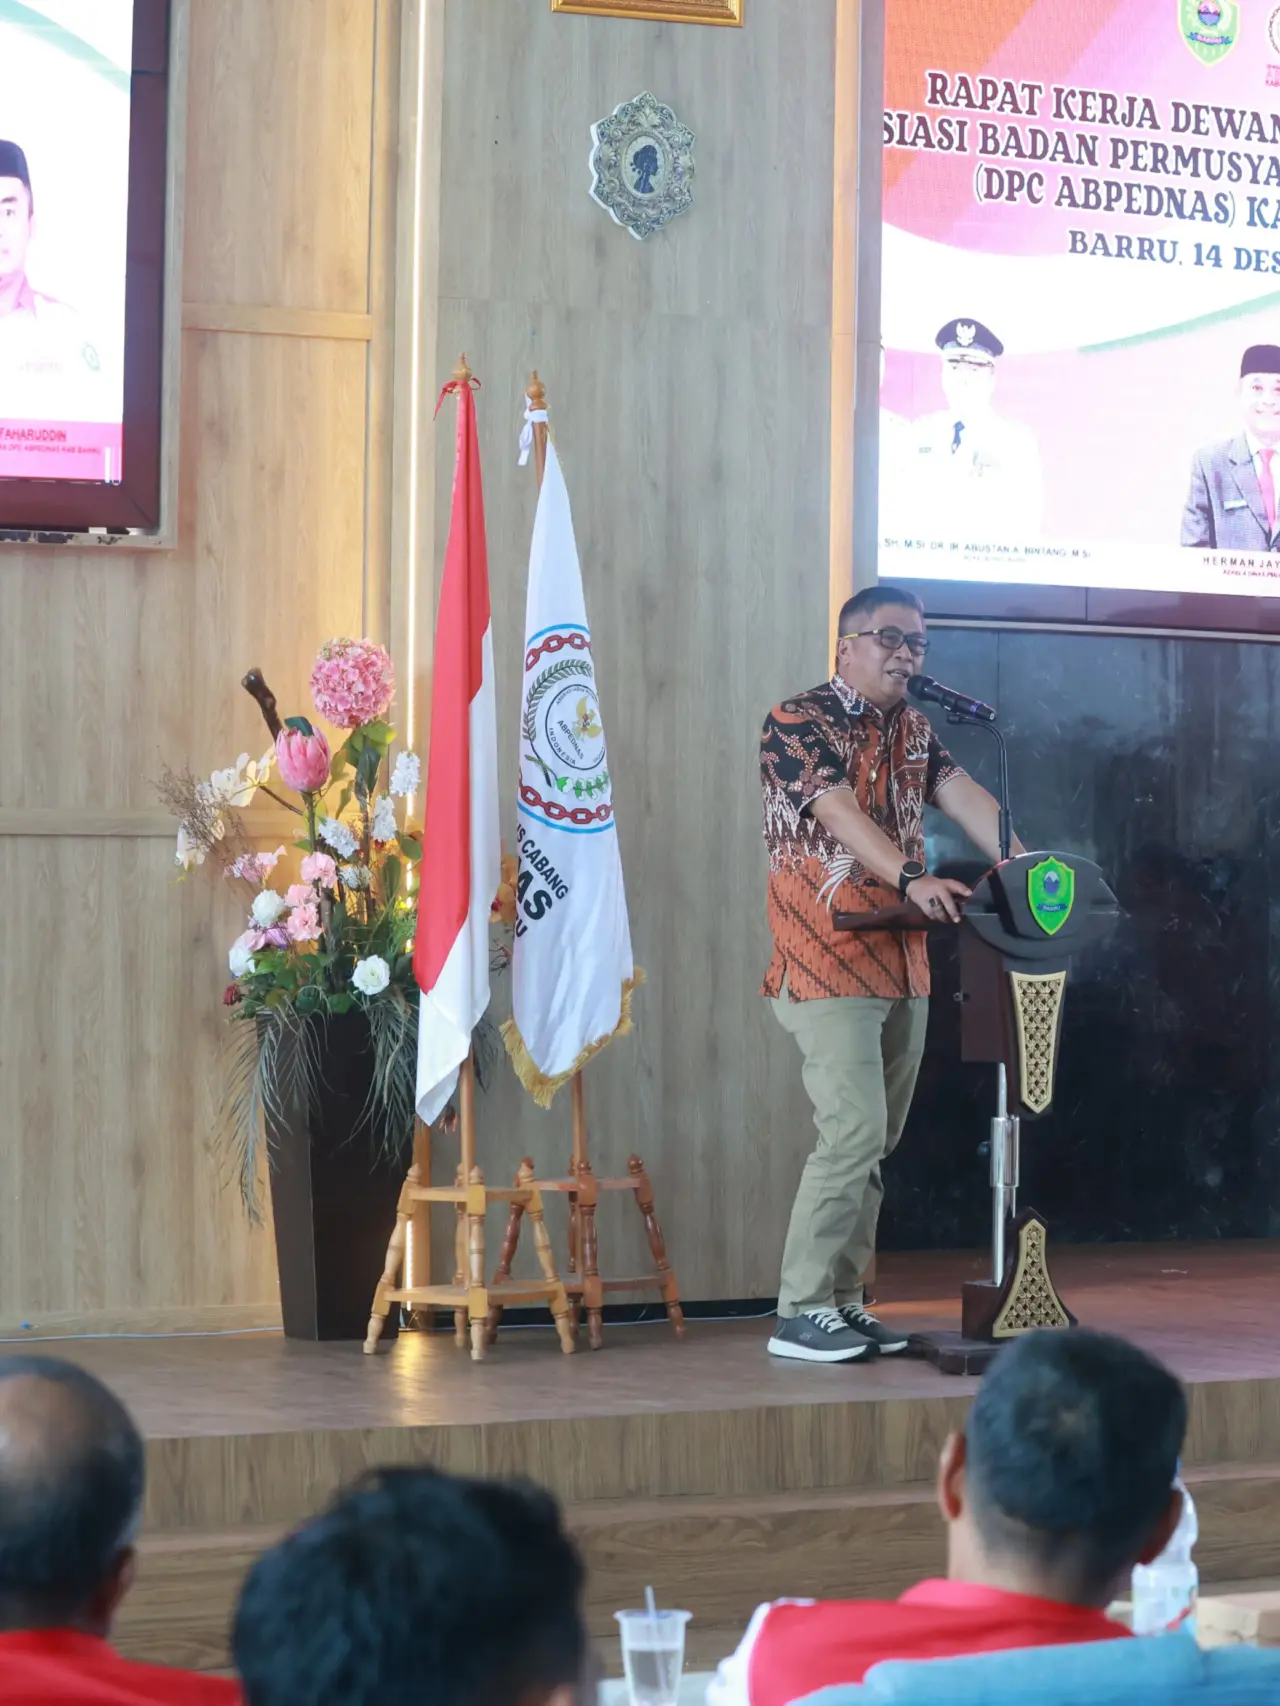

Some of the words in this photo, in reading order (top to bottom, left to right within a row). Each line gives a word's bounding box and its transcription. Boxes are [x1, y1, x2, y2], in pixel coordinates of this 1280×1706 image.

[928, 72, 1043, 116] RAPAT
[1053, 87, 1161, 130] KERJA
[979, 122, 1099, 167] BADAN
[975, 163, 1044, 204] (DPC
[1054, 175, 1235, 229] ABPEDNAS)
[1194, 242, 1223, 268] 14
[1203, 556, 1255, 567] HERMAN
[549, 727, 576, 765] INDONESIA
[557, 719, 584, 760] ABPEDNAS
[521, 839, 569, 900] CABANG
